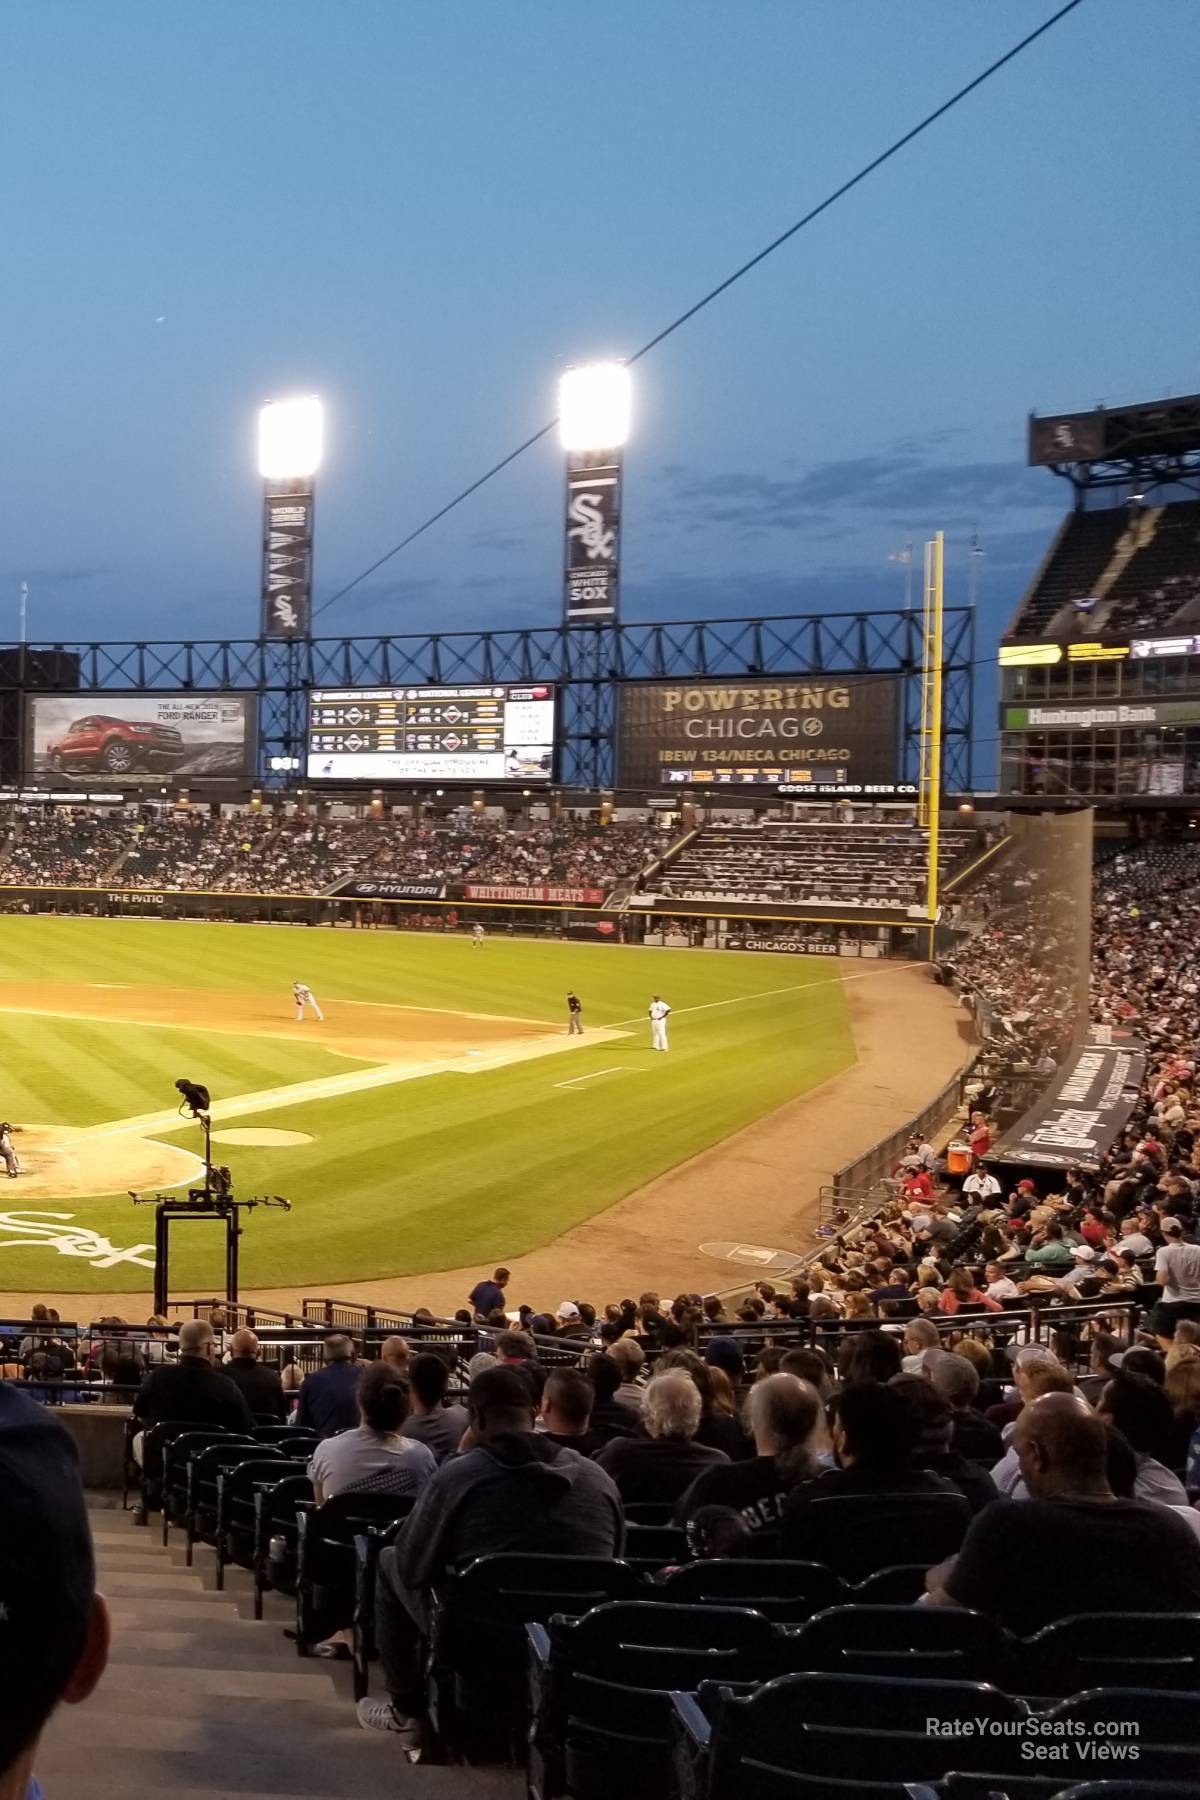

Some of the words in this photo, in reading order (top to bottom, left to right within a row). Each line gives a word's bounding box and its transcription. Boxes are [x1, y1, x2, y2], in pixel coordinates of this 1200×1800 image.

[571, 578, 608, 586] WHITE
[570, 587, 608, 600] SOX
[663, 688, 850, 712] POWERING
[158, 711, 180, 719] FORD
[182, 711, 218, 720] RANGER
[1028, 708, 1117, 727] Huntington
[1118, 706, 1156, 721] Bank
[659, 750, 697, 762] IBEW
[702, 749, 777, 762] 134/NECA
[778, 749, 850, 761] CHICAGO
[778, 785, 817, 793] GOOSE
[819, 785, 862, 793] ISLAND
[865, 785, 895, 793] BEER
[897, 785, 919, 793] CO.
[378, 884, 438, 895] HYUNDAI
[470, 886, 544, 900] WHITTINGHAM
[548, 888, 584, 902] MEATS
[108, 893, 129, 903] THE
[132, 894, 164, 904] PATIO
[745, 940, 806, 952] CHICAGO'S
[808, 943, 837, 954] BEER
